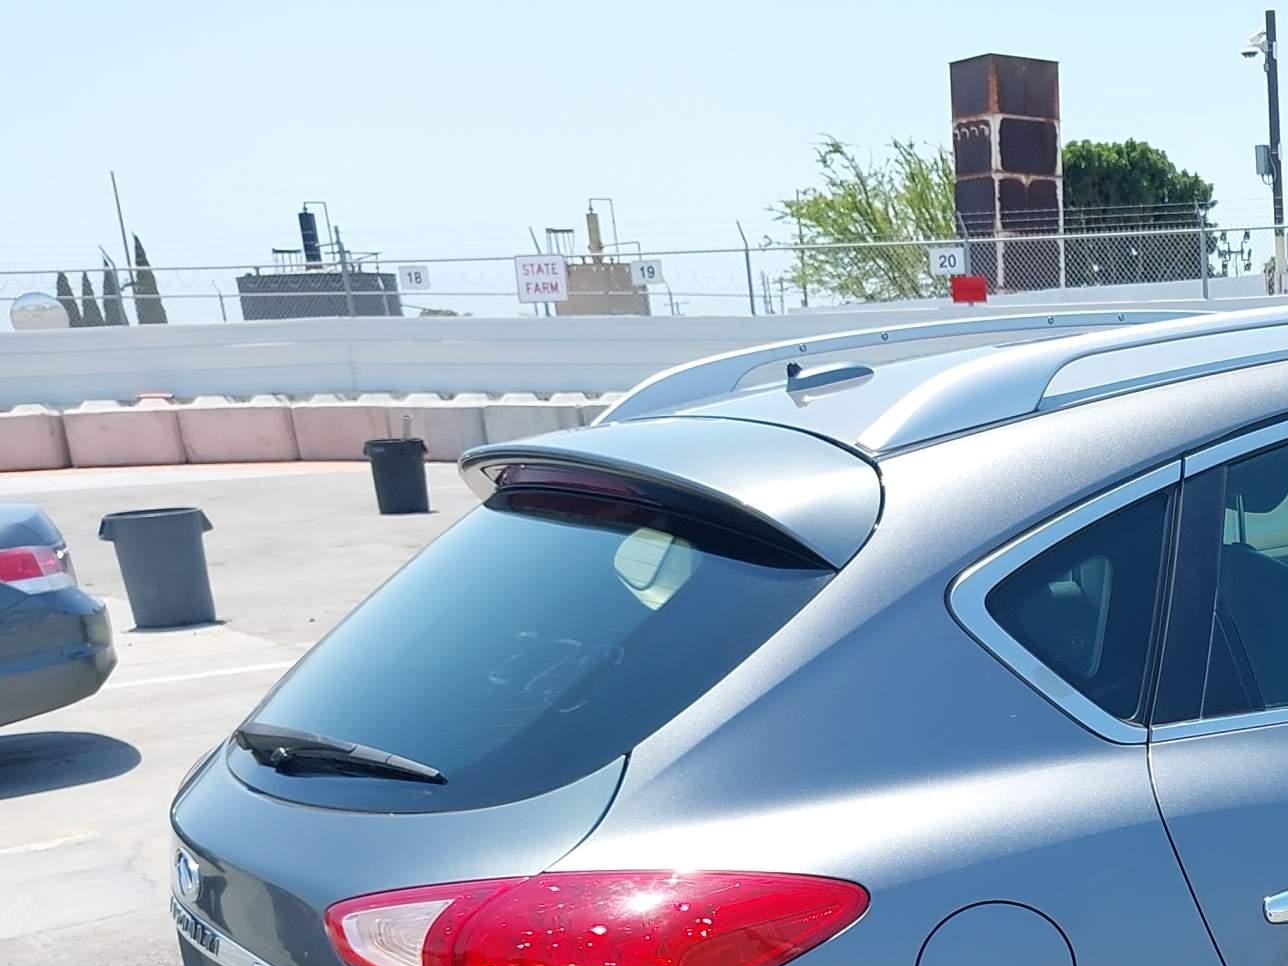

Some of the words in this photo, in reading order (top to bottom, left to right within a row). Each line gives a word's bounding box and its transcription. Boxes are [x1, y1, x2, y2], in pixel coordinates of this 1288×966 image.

[938, 253, 957, 269] 20
[522, 262, 559, 276] STATE
[639, 264, 656, 279] 19
[407, 271, 423, 285] 18
[526, 280, 559, 294] FARM
